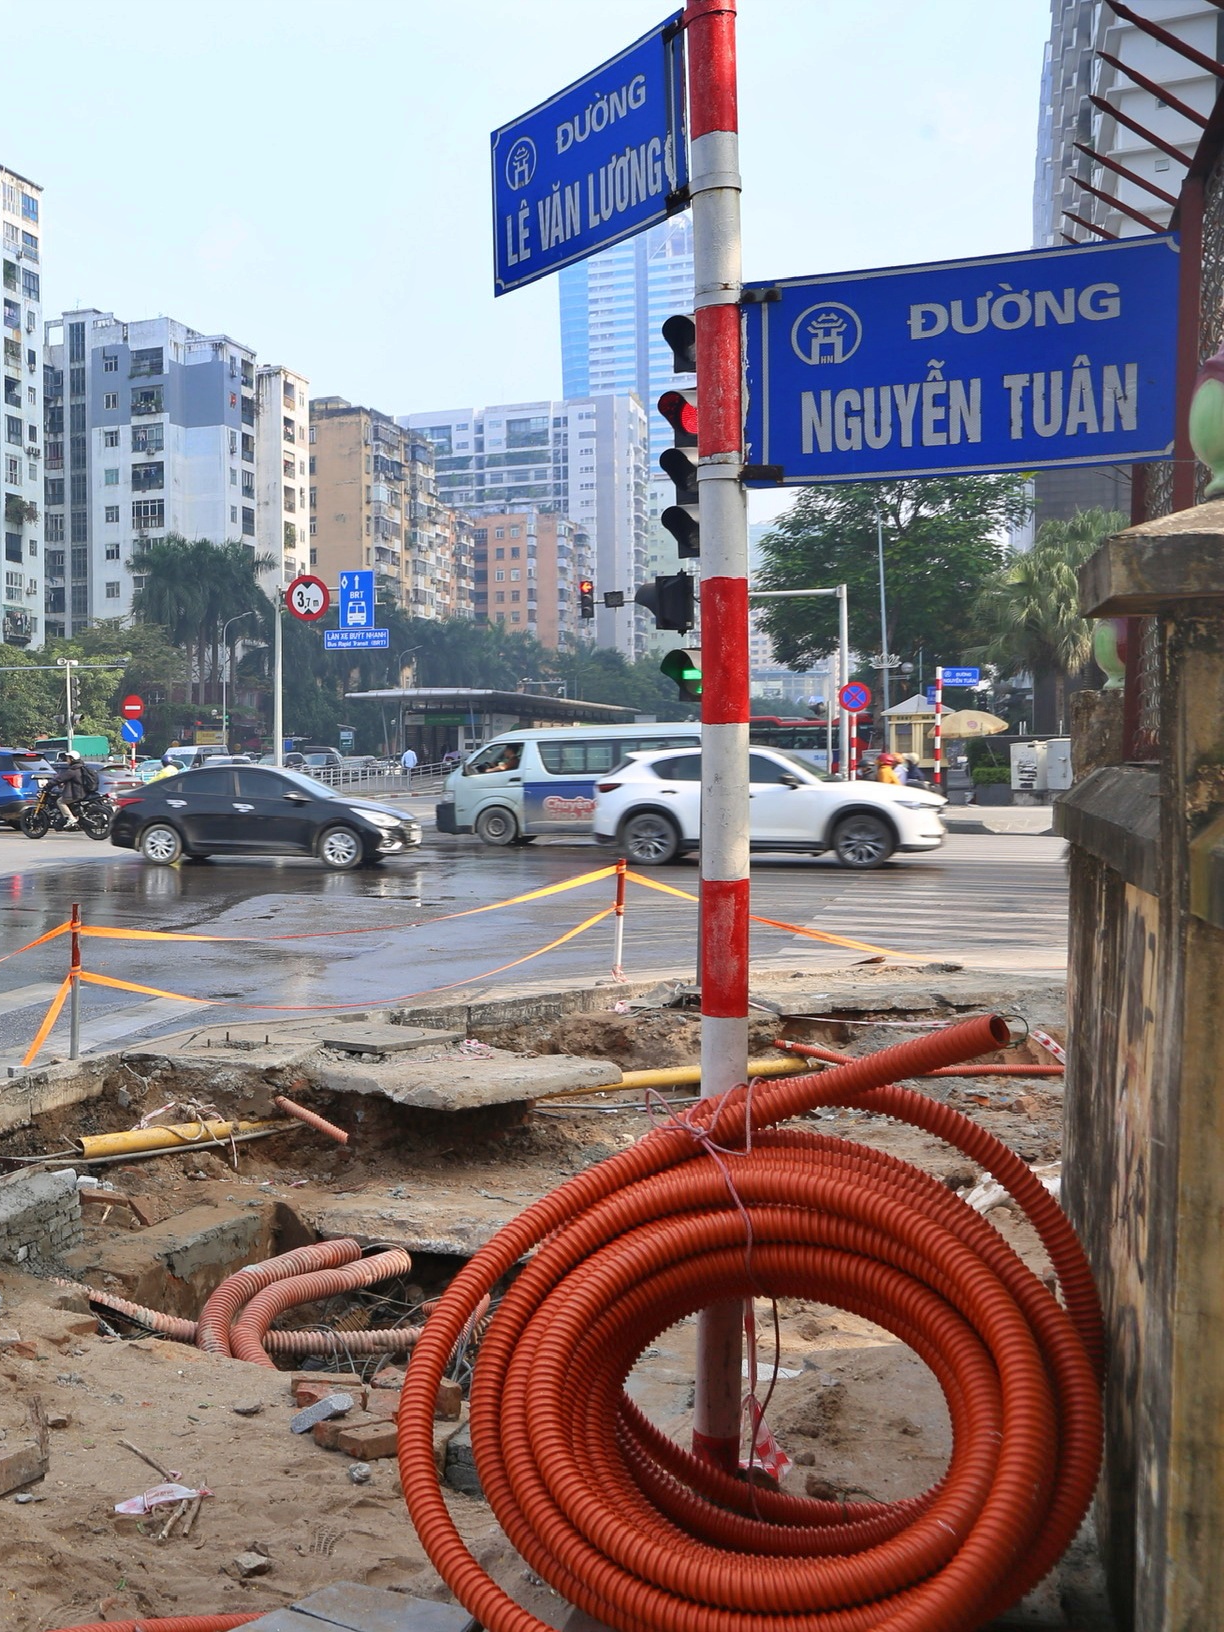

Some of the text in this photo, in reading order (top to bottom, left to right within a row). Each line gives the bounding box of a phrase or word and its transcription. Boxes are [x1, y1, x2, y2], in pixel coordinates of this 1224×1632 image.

[556, 74, 646, 155] ĐƯỜNG
[506, 136, 663, 267] LÊ VĂN LƯƠNG
[907, 282, 1121, 340] ĐƯỜNG
[801, 354, 1138, 454] NGUYỄN TUÂN
[349, 591, 365, 599] BRT
[366, 631, 387, 640] NHANH
